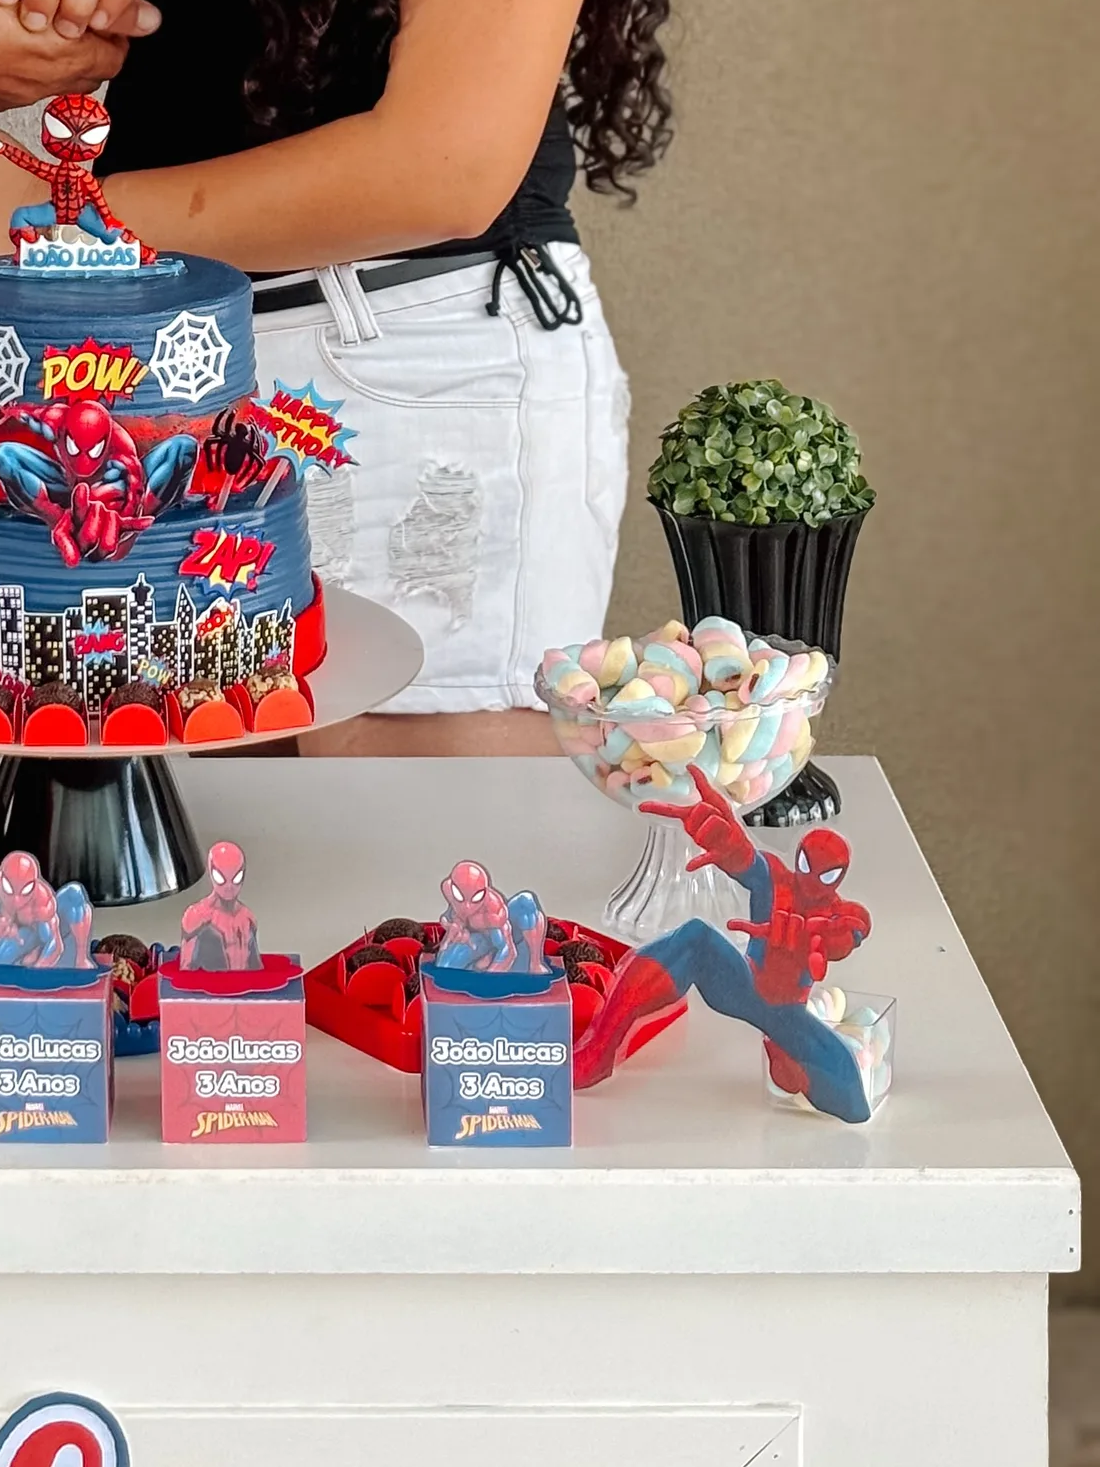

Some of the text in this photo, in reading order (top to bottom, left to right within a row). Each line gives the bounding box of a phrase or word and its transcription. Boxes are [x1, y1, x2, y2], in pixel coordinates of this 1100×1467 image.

[23, 244, 137, 267] JOÃO LUCAS
[44, 351, 150, 400] POW!
[269, 390, 343, 438] HAPPY
[178, 530, 277, 592] ZAP!
[73, 629, 125, 656] BANG
[138, 658, 170, 685] POW
[30, 1034, 101, 1062] Lucas
[167, 1036, 301, 1063] João Lucas
[431, 1037, 566, 1065] João Lucas
[17, 1069, 79, 1096] Anos
[195, 1071, 279, 1097] 3 Anos
[460, 1072, 544, 1099] 3 Anos
